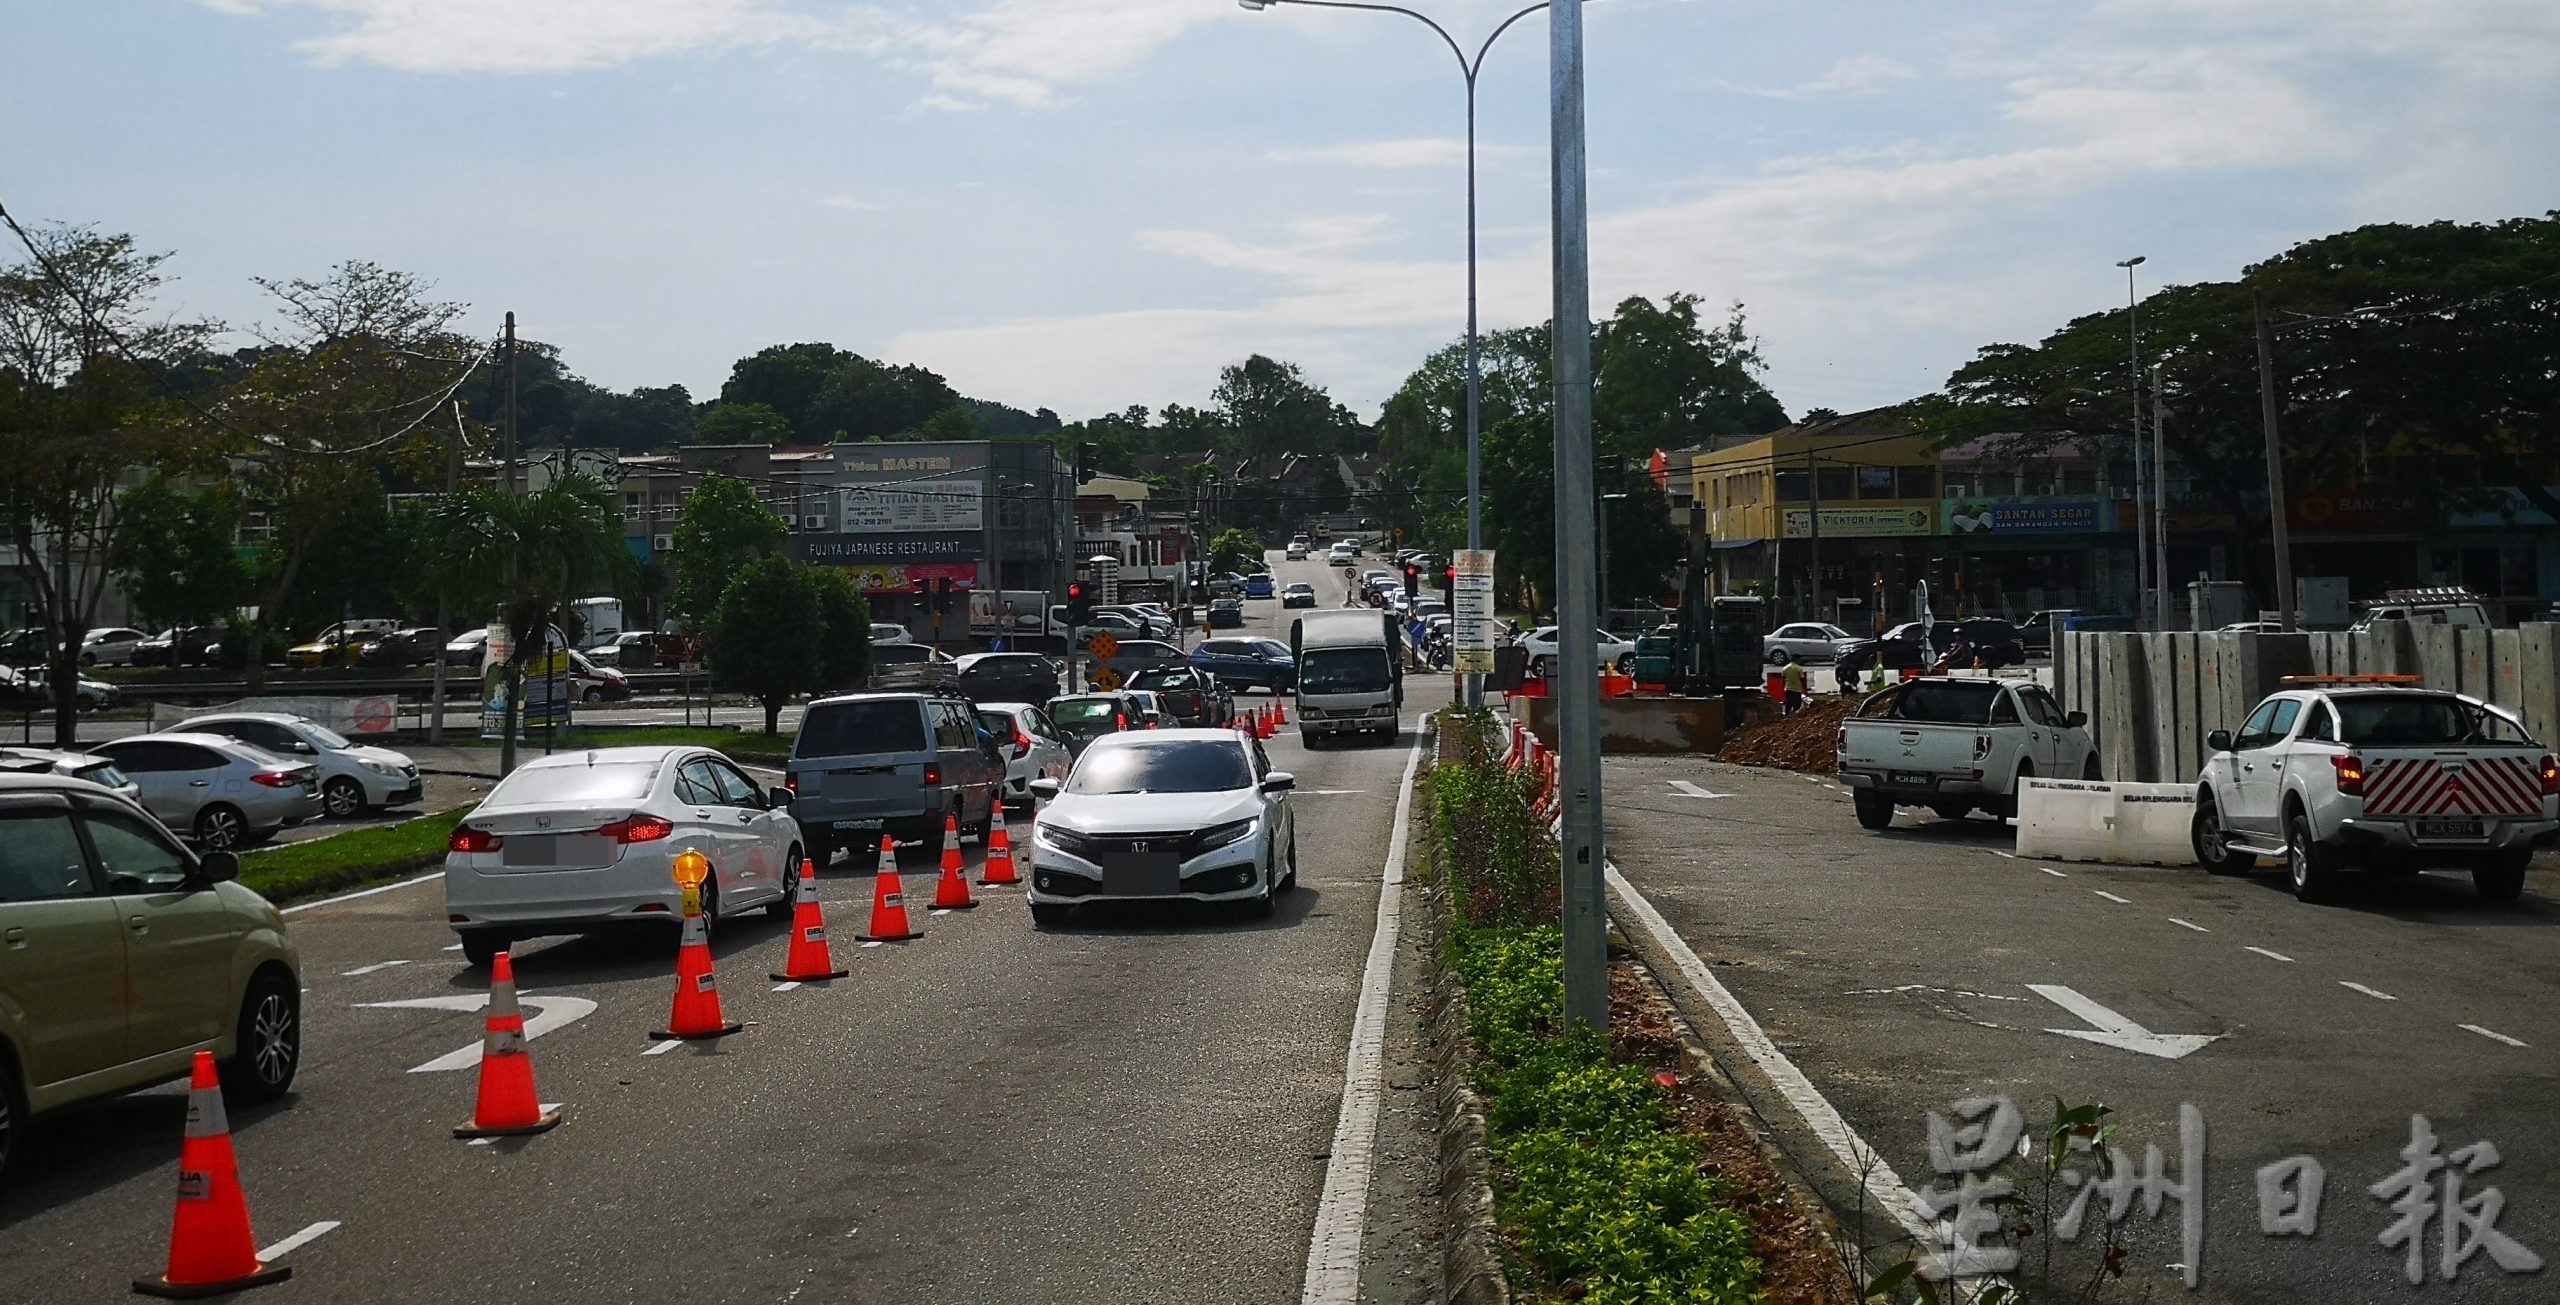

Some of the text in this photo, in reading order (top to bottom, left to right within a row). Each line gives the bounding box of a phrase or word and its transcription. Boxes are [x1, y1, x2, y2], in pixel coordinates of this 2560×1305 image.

[882, 457, 951, 471] MASTERI
[878, 493, 976, 504] TITIAN MASTERI
[1995, 508, 2092, 520] SANTAN SEGAR
[809, 541, 961, 557] FUJIYA JAPANESE RESTAURANT
